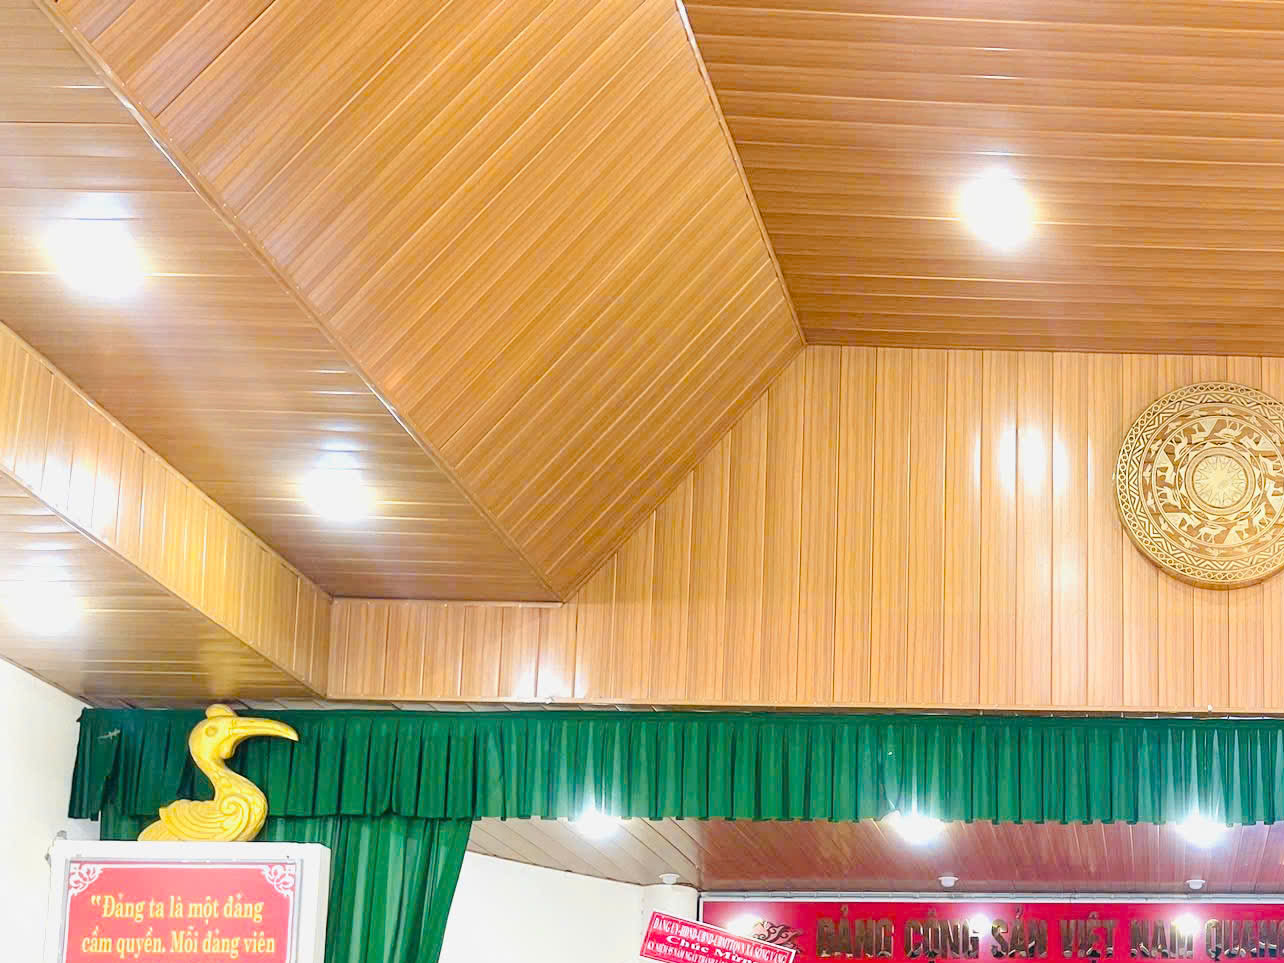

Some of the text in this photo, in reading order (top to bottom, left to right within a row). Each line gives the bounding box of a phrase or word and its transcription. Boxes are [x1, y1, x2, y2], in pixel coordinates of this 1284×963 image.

[149, 899, 164, 919] ta
[169, 895, 184, 919] là
[188, 898, 219, 924] một
[223, 892, 264, 923] đảng
[81, 925, 275, 958] cầm quyền. Mỗi đảng viên
[666, 935, 710, 953] Chúc
[816, 905, 894, 960] ĐẢNG
[990, 906, 1048, 960] SẢN
[1129, 918, 1193, 960] NAM
